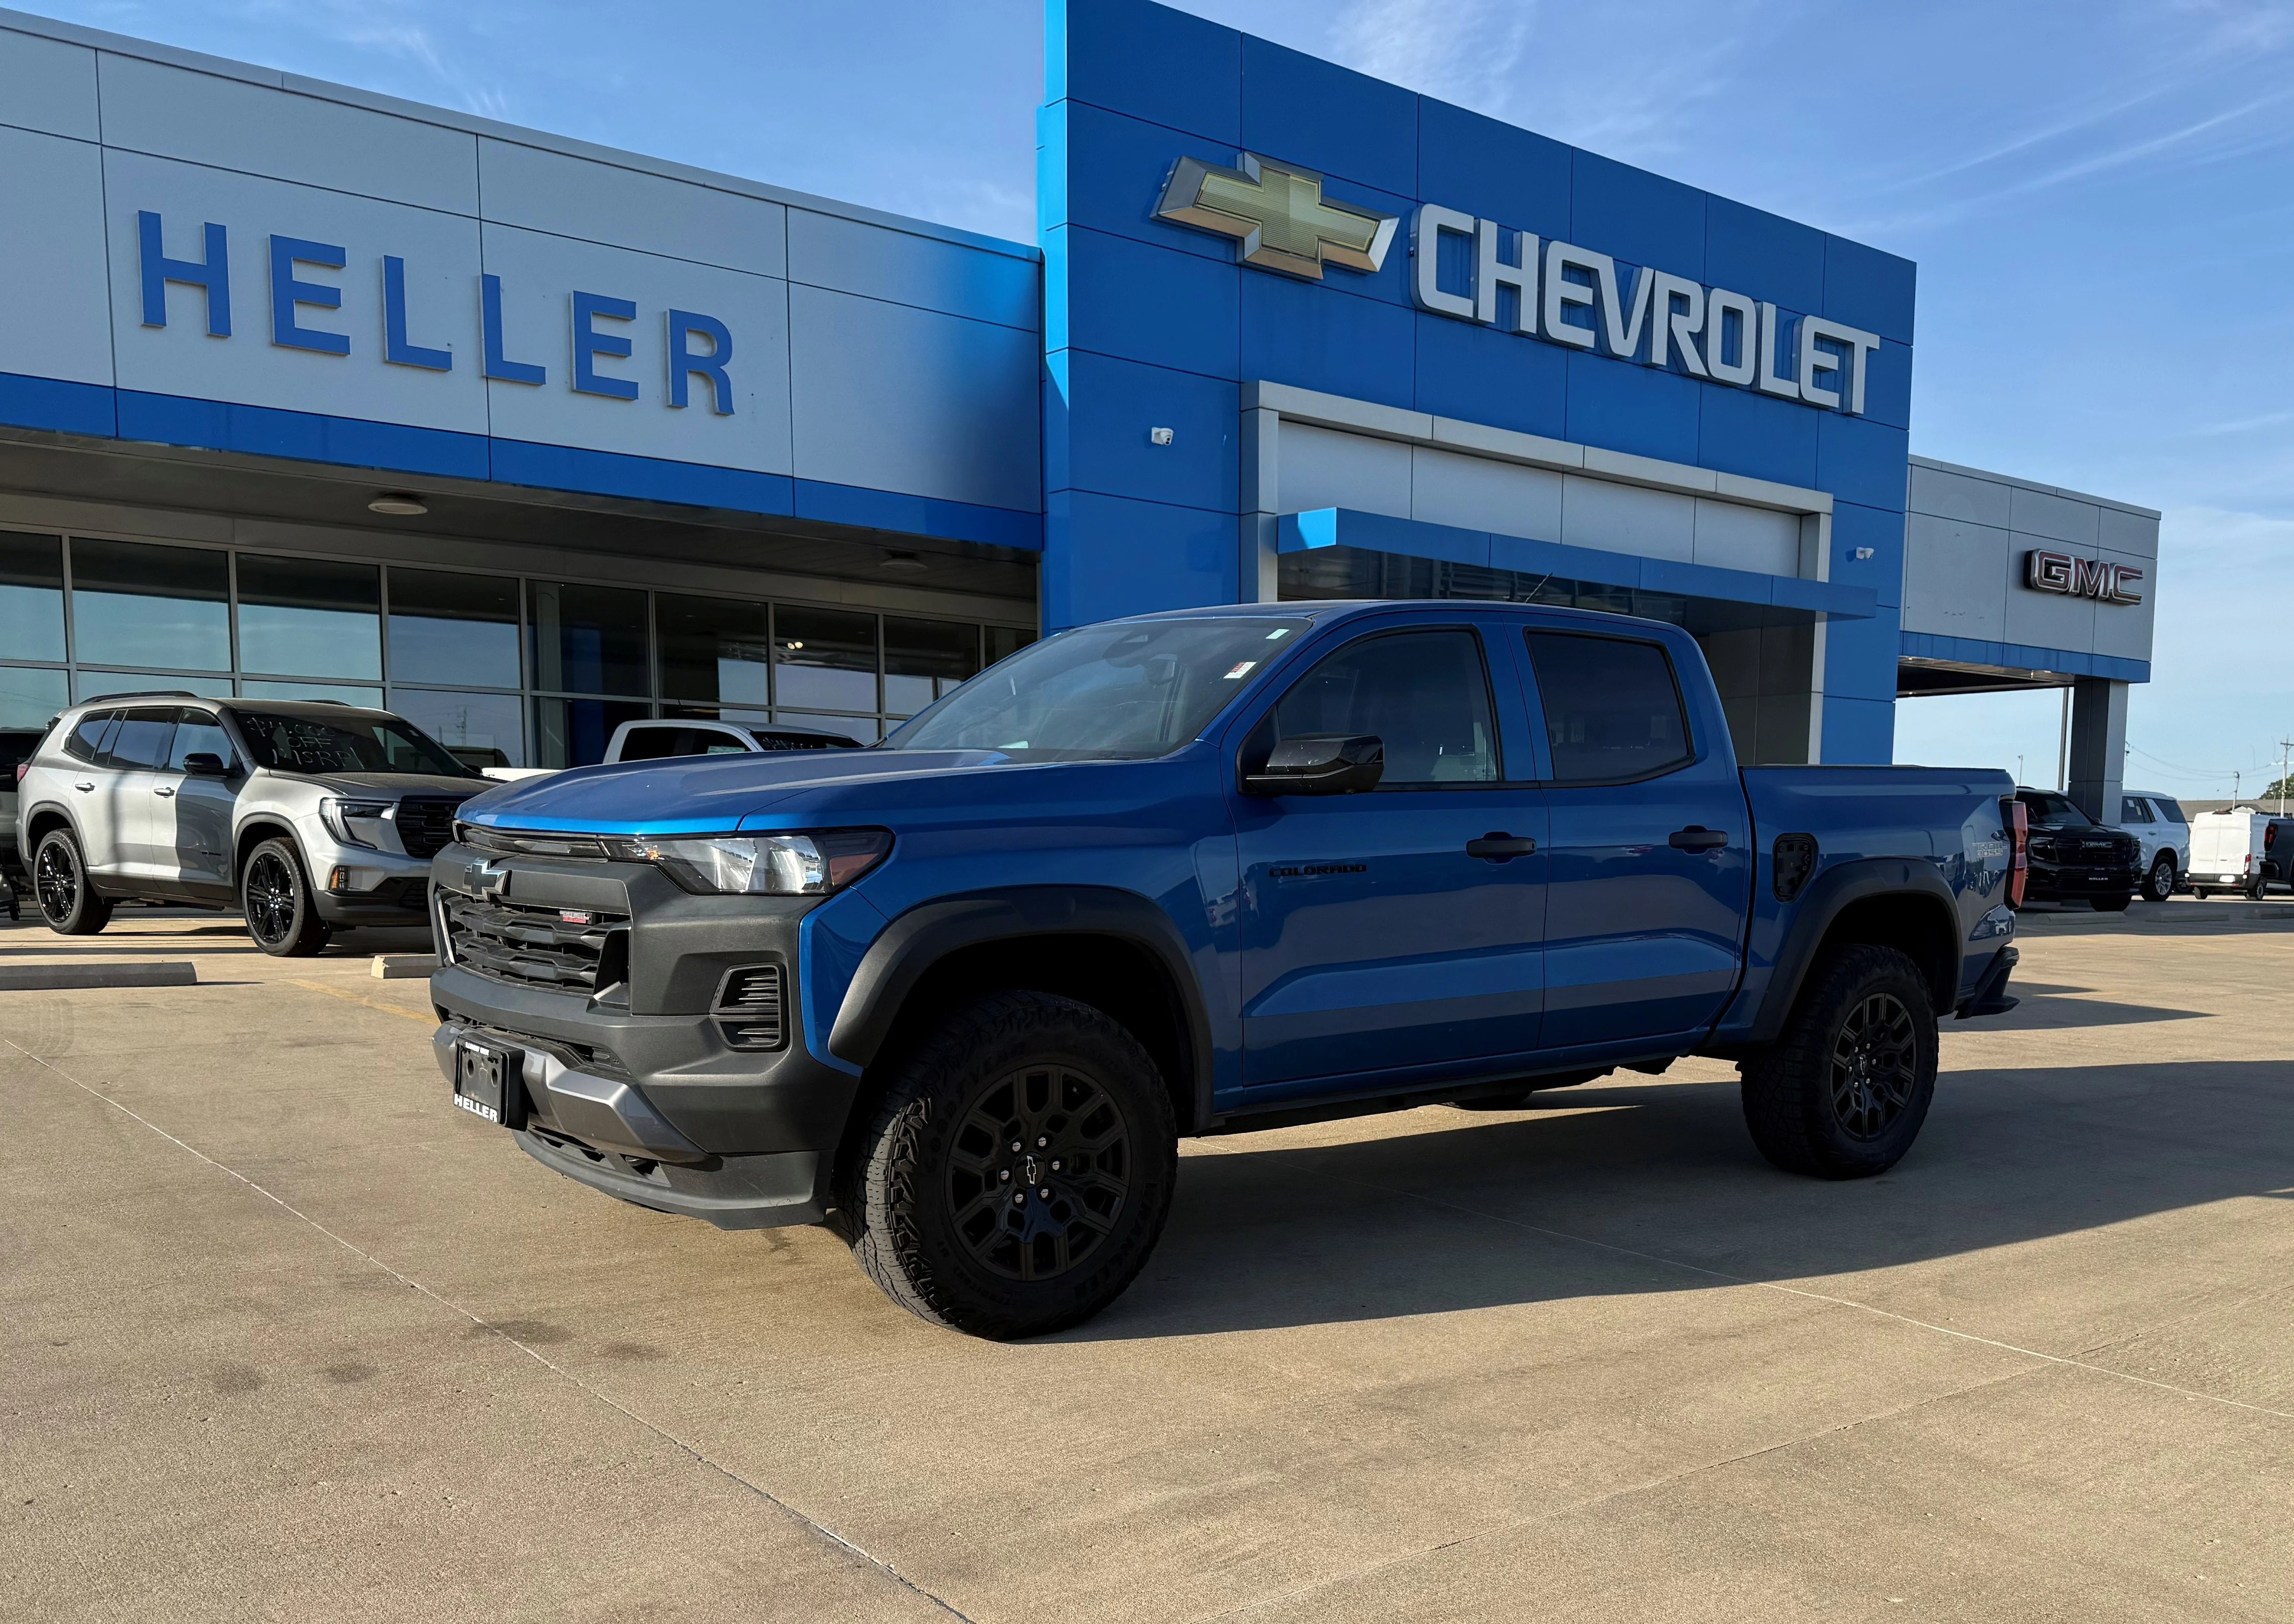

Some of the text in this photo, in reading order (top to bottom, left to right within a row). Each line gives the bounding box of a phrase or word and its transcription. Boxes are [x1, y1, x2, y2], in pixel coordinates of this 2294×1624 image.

[138, 210, 735, 416] HELLER
[1410, 203, 1880, 415] CHEVROLET
[2028, 549, 2144, 606] GMC
[287, 737, 331, 748] OFF
[1972, 841, 2008, 851] TRAIL
[1976, 850, 2003, 858] BOSS
[1269, 865, 1367, 877] COLORADO
[454, 1093, 498, 1124] HELLER
